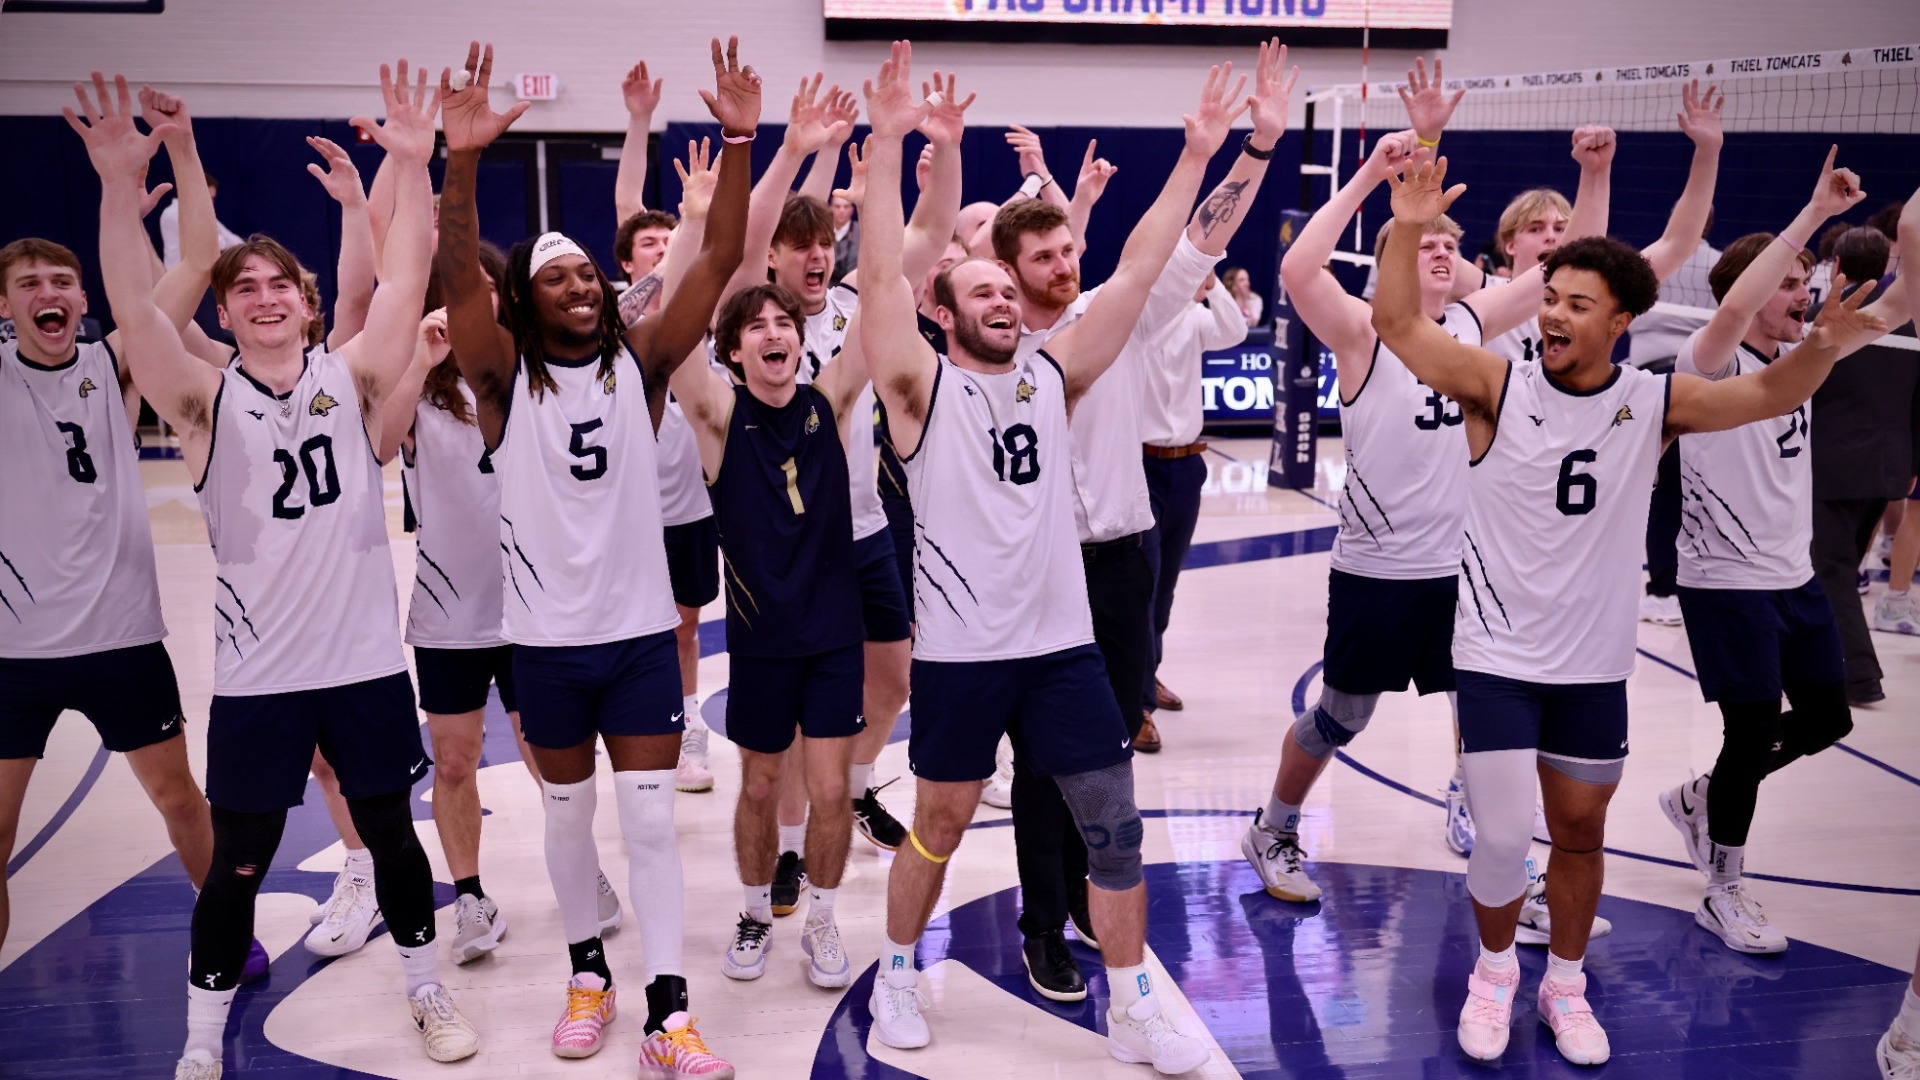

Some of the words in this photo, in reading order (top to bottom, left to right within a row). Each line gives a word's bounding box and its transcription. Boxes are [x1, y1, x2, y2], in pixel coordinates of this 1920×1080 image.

[1616, 68, 1642, 80] THIEL
[1644, 64, 1690, 79] TOMCATS
[1731, 59, 1763, 73] THIEL
[1766, 54, 1822, 71] TOMCATS
[1873, 47, 1914, 63] THIEL
[523, 75, 551, 96] EXIT
[272, 433, 341, 520] 20
[568, 417, 608, 481] 5
[988, 422, 1041, 485] 18
[781, 456, 805, 514] 1
[1556, 448, 1597, 516] 6
